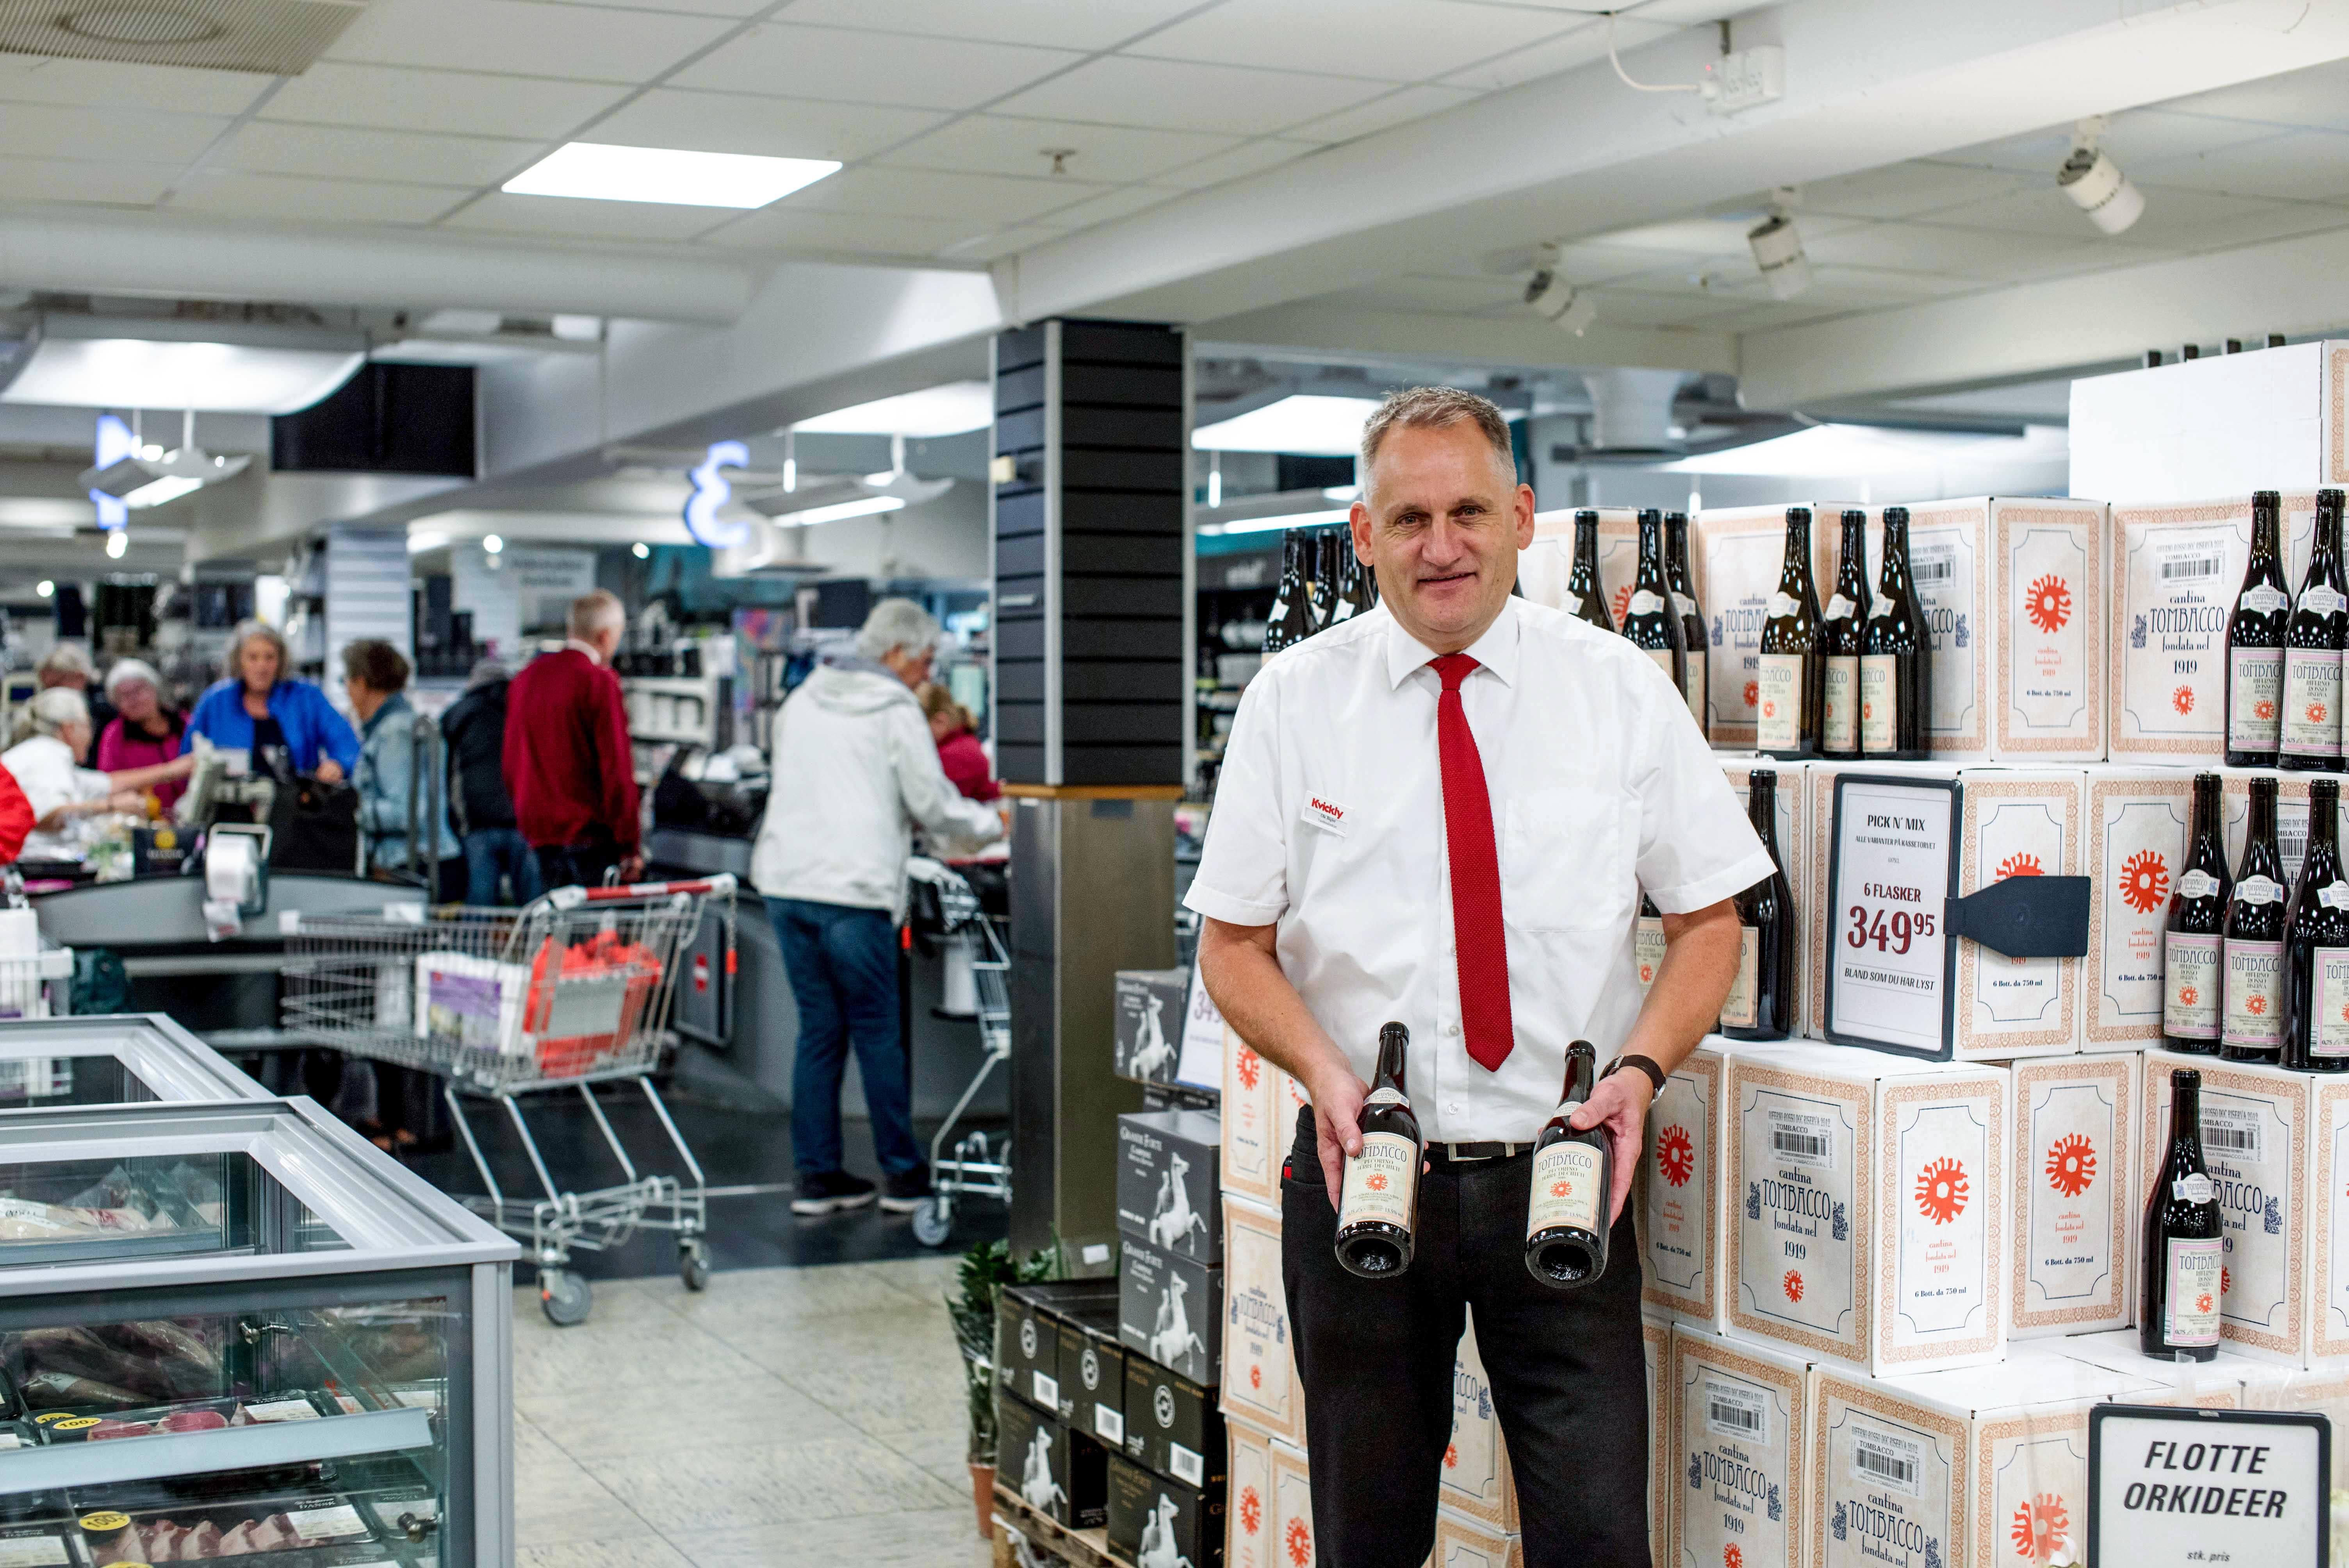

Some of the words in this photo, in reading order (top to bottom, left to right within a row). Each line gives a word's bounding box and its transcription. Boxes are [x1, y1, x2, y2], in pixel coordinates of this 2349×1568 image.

[2170, 590, 2205, 603] cantina
[2150, 606, 2224, 633] TOMBACCO
[2163, 635, 2194, 653] fondata
[2197, 635, 2209, 650] nel
[2042, 668, 2055, 677] 1919
[2174, 659, 2198, 674] 1919
[1312, 798, 1344, 819] Kvickly
[1867, 814, 1890, 828] PICK
[1905, 818, 1925, 831] MIX
[1868, 837, 1894, 846] VARIANTER
[1901, 840, 1936, 850] KASSETORVET
[1864, 882, 1871, 896] 6
[1873, 884, 1921, 902] FLASKER
[1848, 906, 1912, 954] 349
[1914, 913, 1935, 936] 95
[2132, 927, 2153, 935] cantina
[2169, 949, 2216, 965] TOMBACCO
[1845, 968, 1869, 980] BLAND
[1870, 972, 1887, 983] SOM
[1888, 974, 1899, 985] DU
[1900, 976, 1914, 987] HAR
[1916, 978, 1935, 991] LYST
[1784, 1113, 1796, 1123] ROSSO
[1804, 1115, 1820, 1126] RISERVA
[1820, 1117, 1830, 1127] 2012
[2205, 1108, 2218, 1117] ROSSO
[2228, 1110, 2246, 1120] RISERVA
[2247, 1112, 2258, 1121] 2012
[1776, 1123, 1808, 1133] TOMBACCO
[2200, 1119, 2233, 1128] OMBACCO
[1538, 1154, 1592, 1173] TOMBACCO
[1779, 1166, 1812, 1184] cantina
[1763, 1178, 1830, 1220] TOMBACCO
[1774, 1211, 1802, 1233] fondata
[1805, 1221, 1817, 1237] nel
[2055, 1223, 2075, 1232] fondata
[2231, 1214, 2246, 1231] nel
[1929, 1240, 1953, 1249] cantina
[2062, 1234, 2077, 1243] 1919
[1784, 1240, 1806, 1260] 1919
[1926, 1252, 1946, 1262] fondata
[1948, 1251, 1956, 1260] nel
[1933, 1265, 1949, 1274] 1919
[1921, 1289, 1934, 1297] Bott.
[1713, 1395, 1743, 1407] TOMBACCO
[1719, 1444, 1749, 1463] cantina
[1859, 1440, 1894, 1456] TOMBACCO
[2144, 1441, 2270, 1474] FLOTTE
[1704, 1451, 1766, 1499] TOMBACCO
[1715, 1483, 1741, 1509] fondata
[1743, 1499, 1754, 1514] nel
[1868, 1493, 1903, 1514] cantina
[2123, 1482, 2288, 1519] ORKIDEER
[1723, 1513, 1744, 1534] 1919
[1850, 1500, 1923, 1553] TOMBACCO
[1862, 1535, 1893, 1563] fondata
[1895, 1552, 1908, 1568] nel
[2187, 1551, 2206, 1561] stk.
[2209, 1552, 2231, 1563] pris
